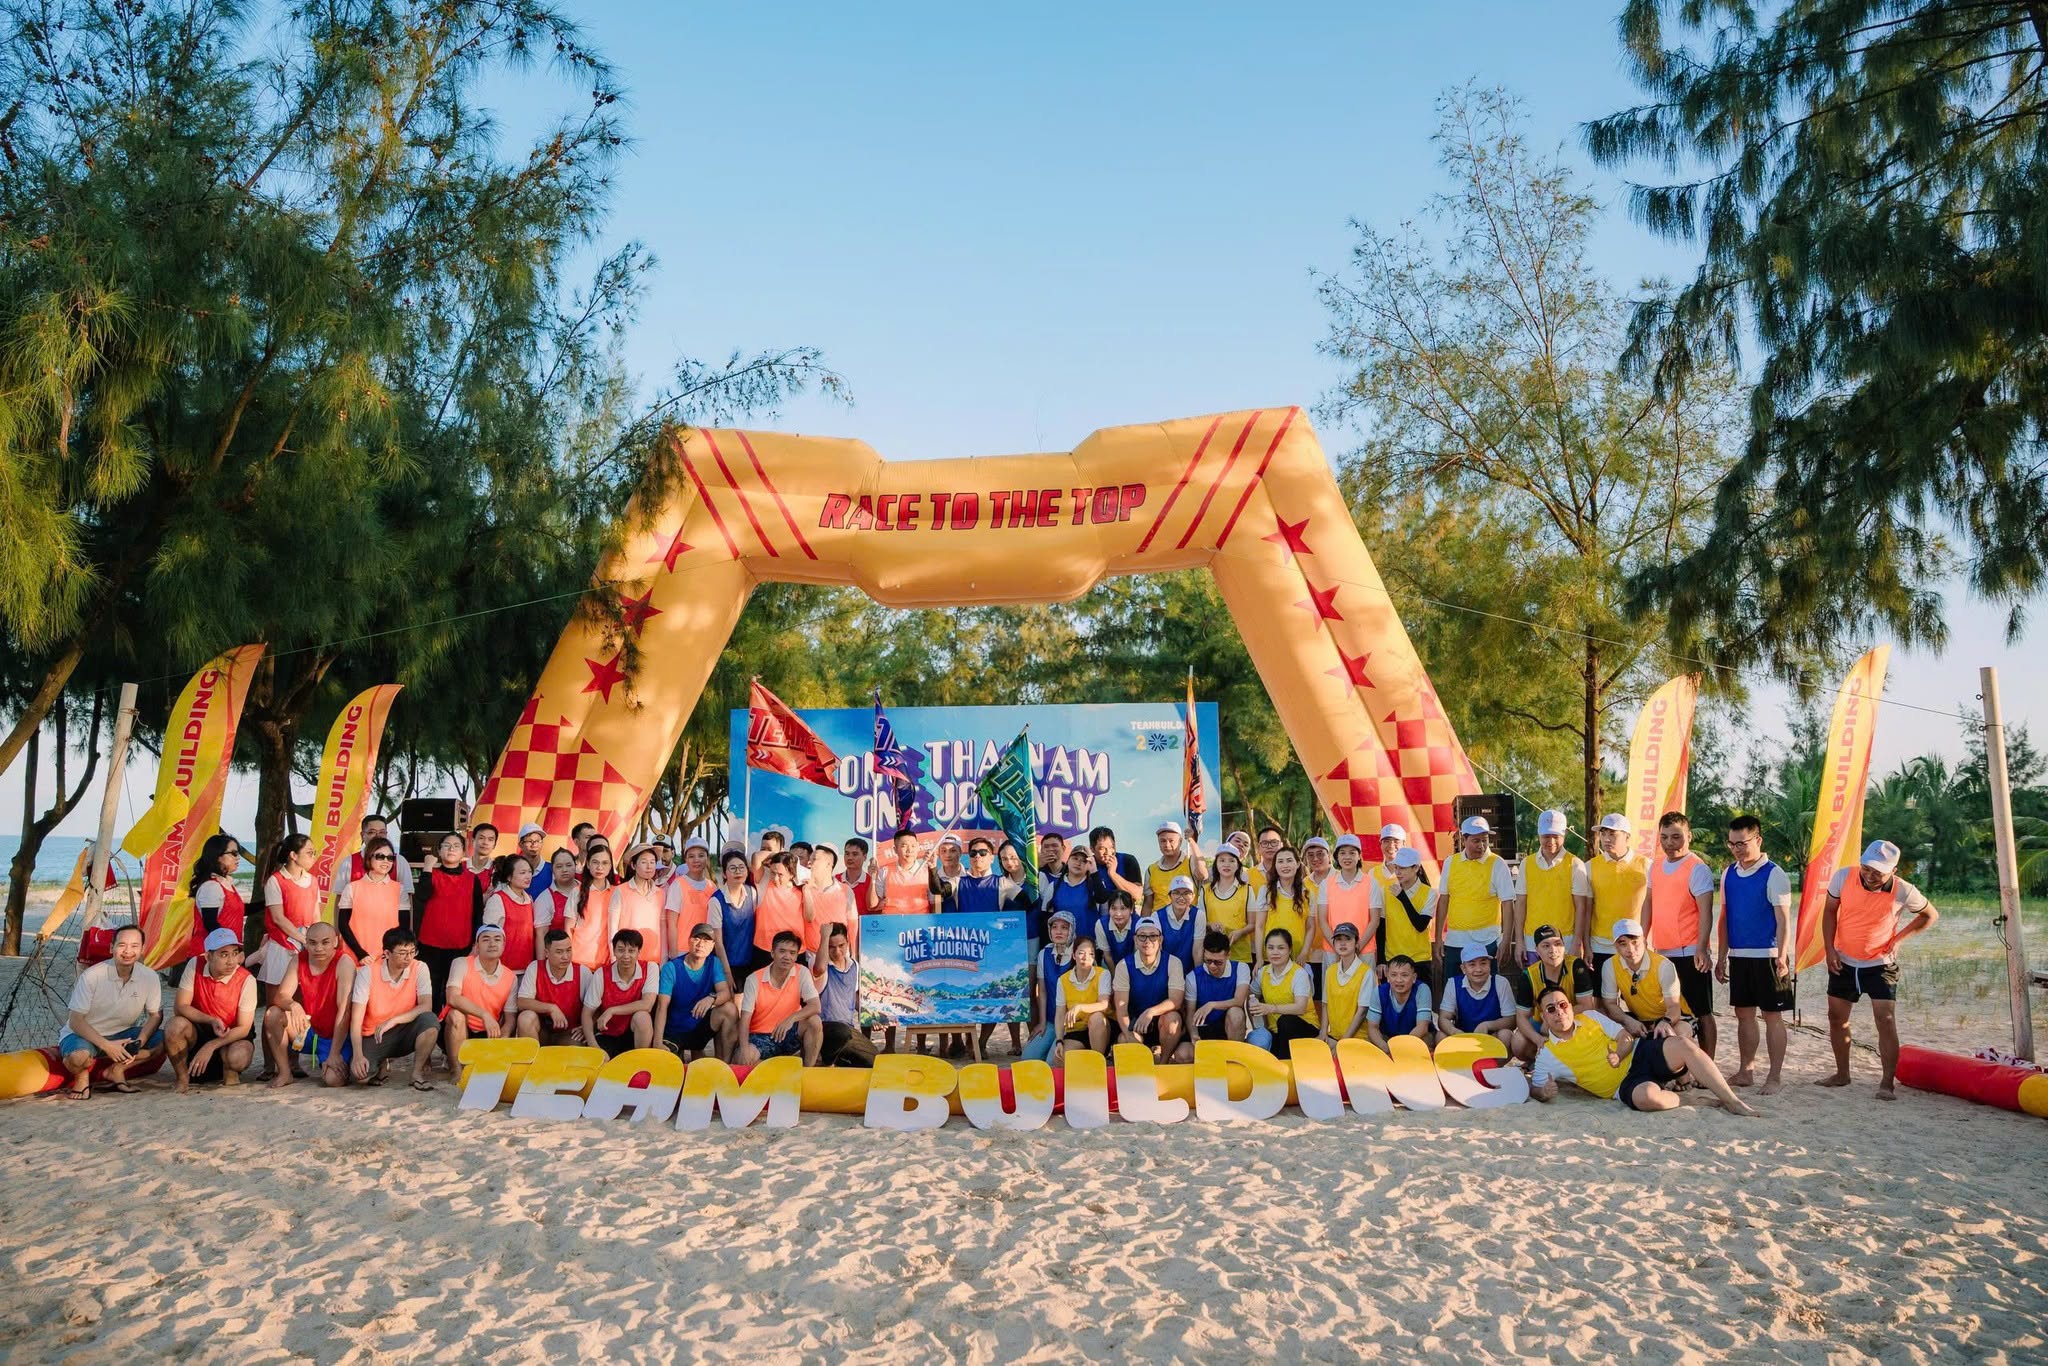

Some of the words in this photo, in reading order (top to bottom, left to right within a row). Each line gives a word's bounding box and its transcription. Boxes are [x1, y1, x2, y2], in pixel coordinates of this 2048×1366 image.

[819, 493, 921, 531] RACE
[930, 492, 979, 530] TO
[990, 489, 1062, 528] THE
[1071, 483, 1146, 525] TOP
[1130, 721, 1186, 731] TEAMBUILD
[159, 818, 186, 901] TEAM
[174, 669, 219, 799] UILDING
[326, 705, 363, 827] BUILDING
[839, 744, 910, 795] ON
[925, 740, 1110, 792] THANAM
[1640, 700, 1668, 821] BUILDING
[935, 782, 1093, 832] JONEY
[1815, 821, 1842, 901] TEAM
[1832, 676, 1863, 812] BUILDING
[898, 927, 923, 947] ONE
[928, 925, 991, 944] THAINAM
[904, 943, 928, 961] ONE
[932, 940, 986, 959] JOURNEY
[458, 1038, 803, 1131] TEAM
[864, 1033, 1530, 1132] BUILDING
